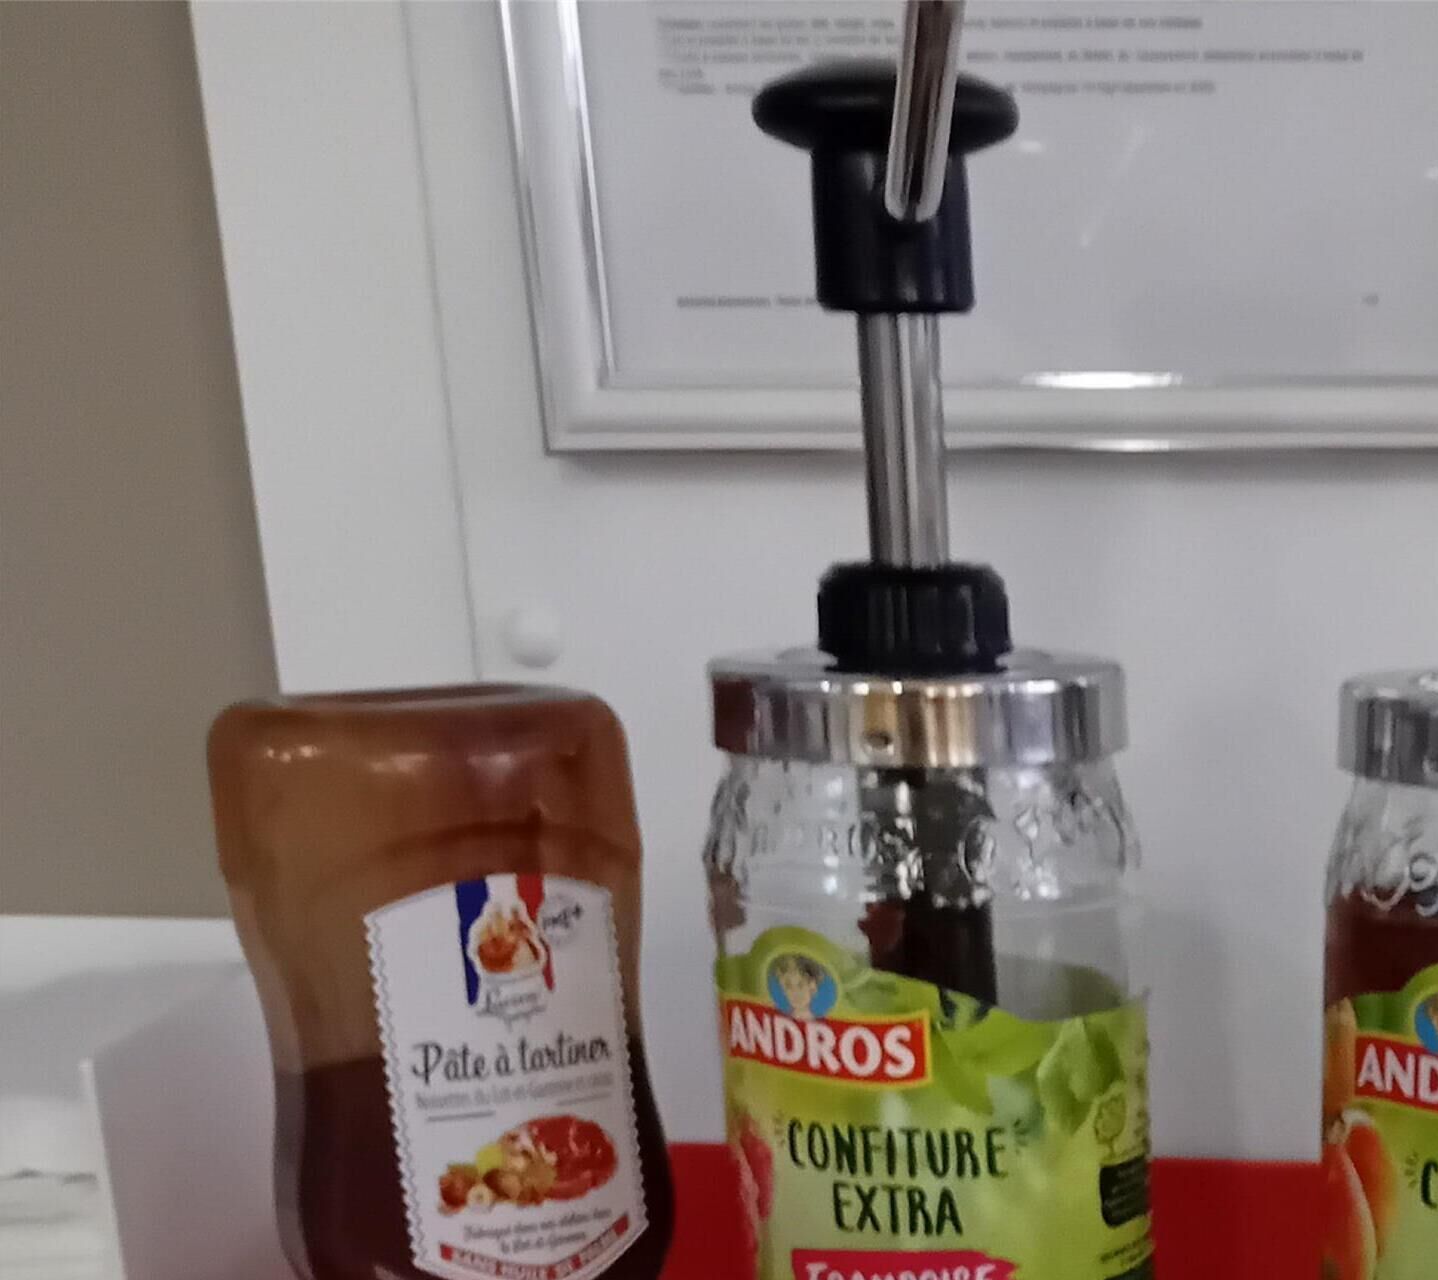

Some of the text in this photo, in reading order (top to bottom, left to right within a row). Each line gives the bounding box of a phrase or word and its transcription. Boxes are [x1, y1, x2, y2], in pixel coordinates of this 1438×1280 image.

[411, 1031, 613, 1086] Pâte à tartiner
[730, 1007, 917, 1078] ANDROS
[786, 1118, 1009, 1180] CONFITURE
[834, 1182, 963, 1236] EXTRA
